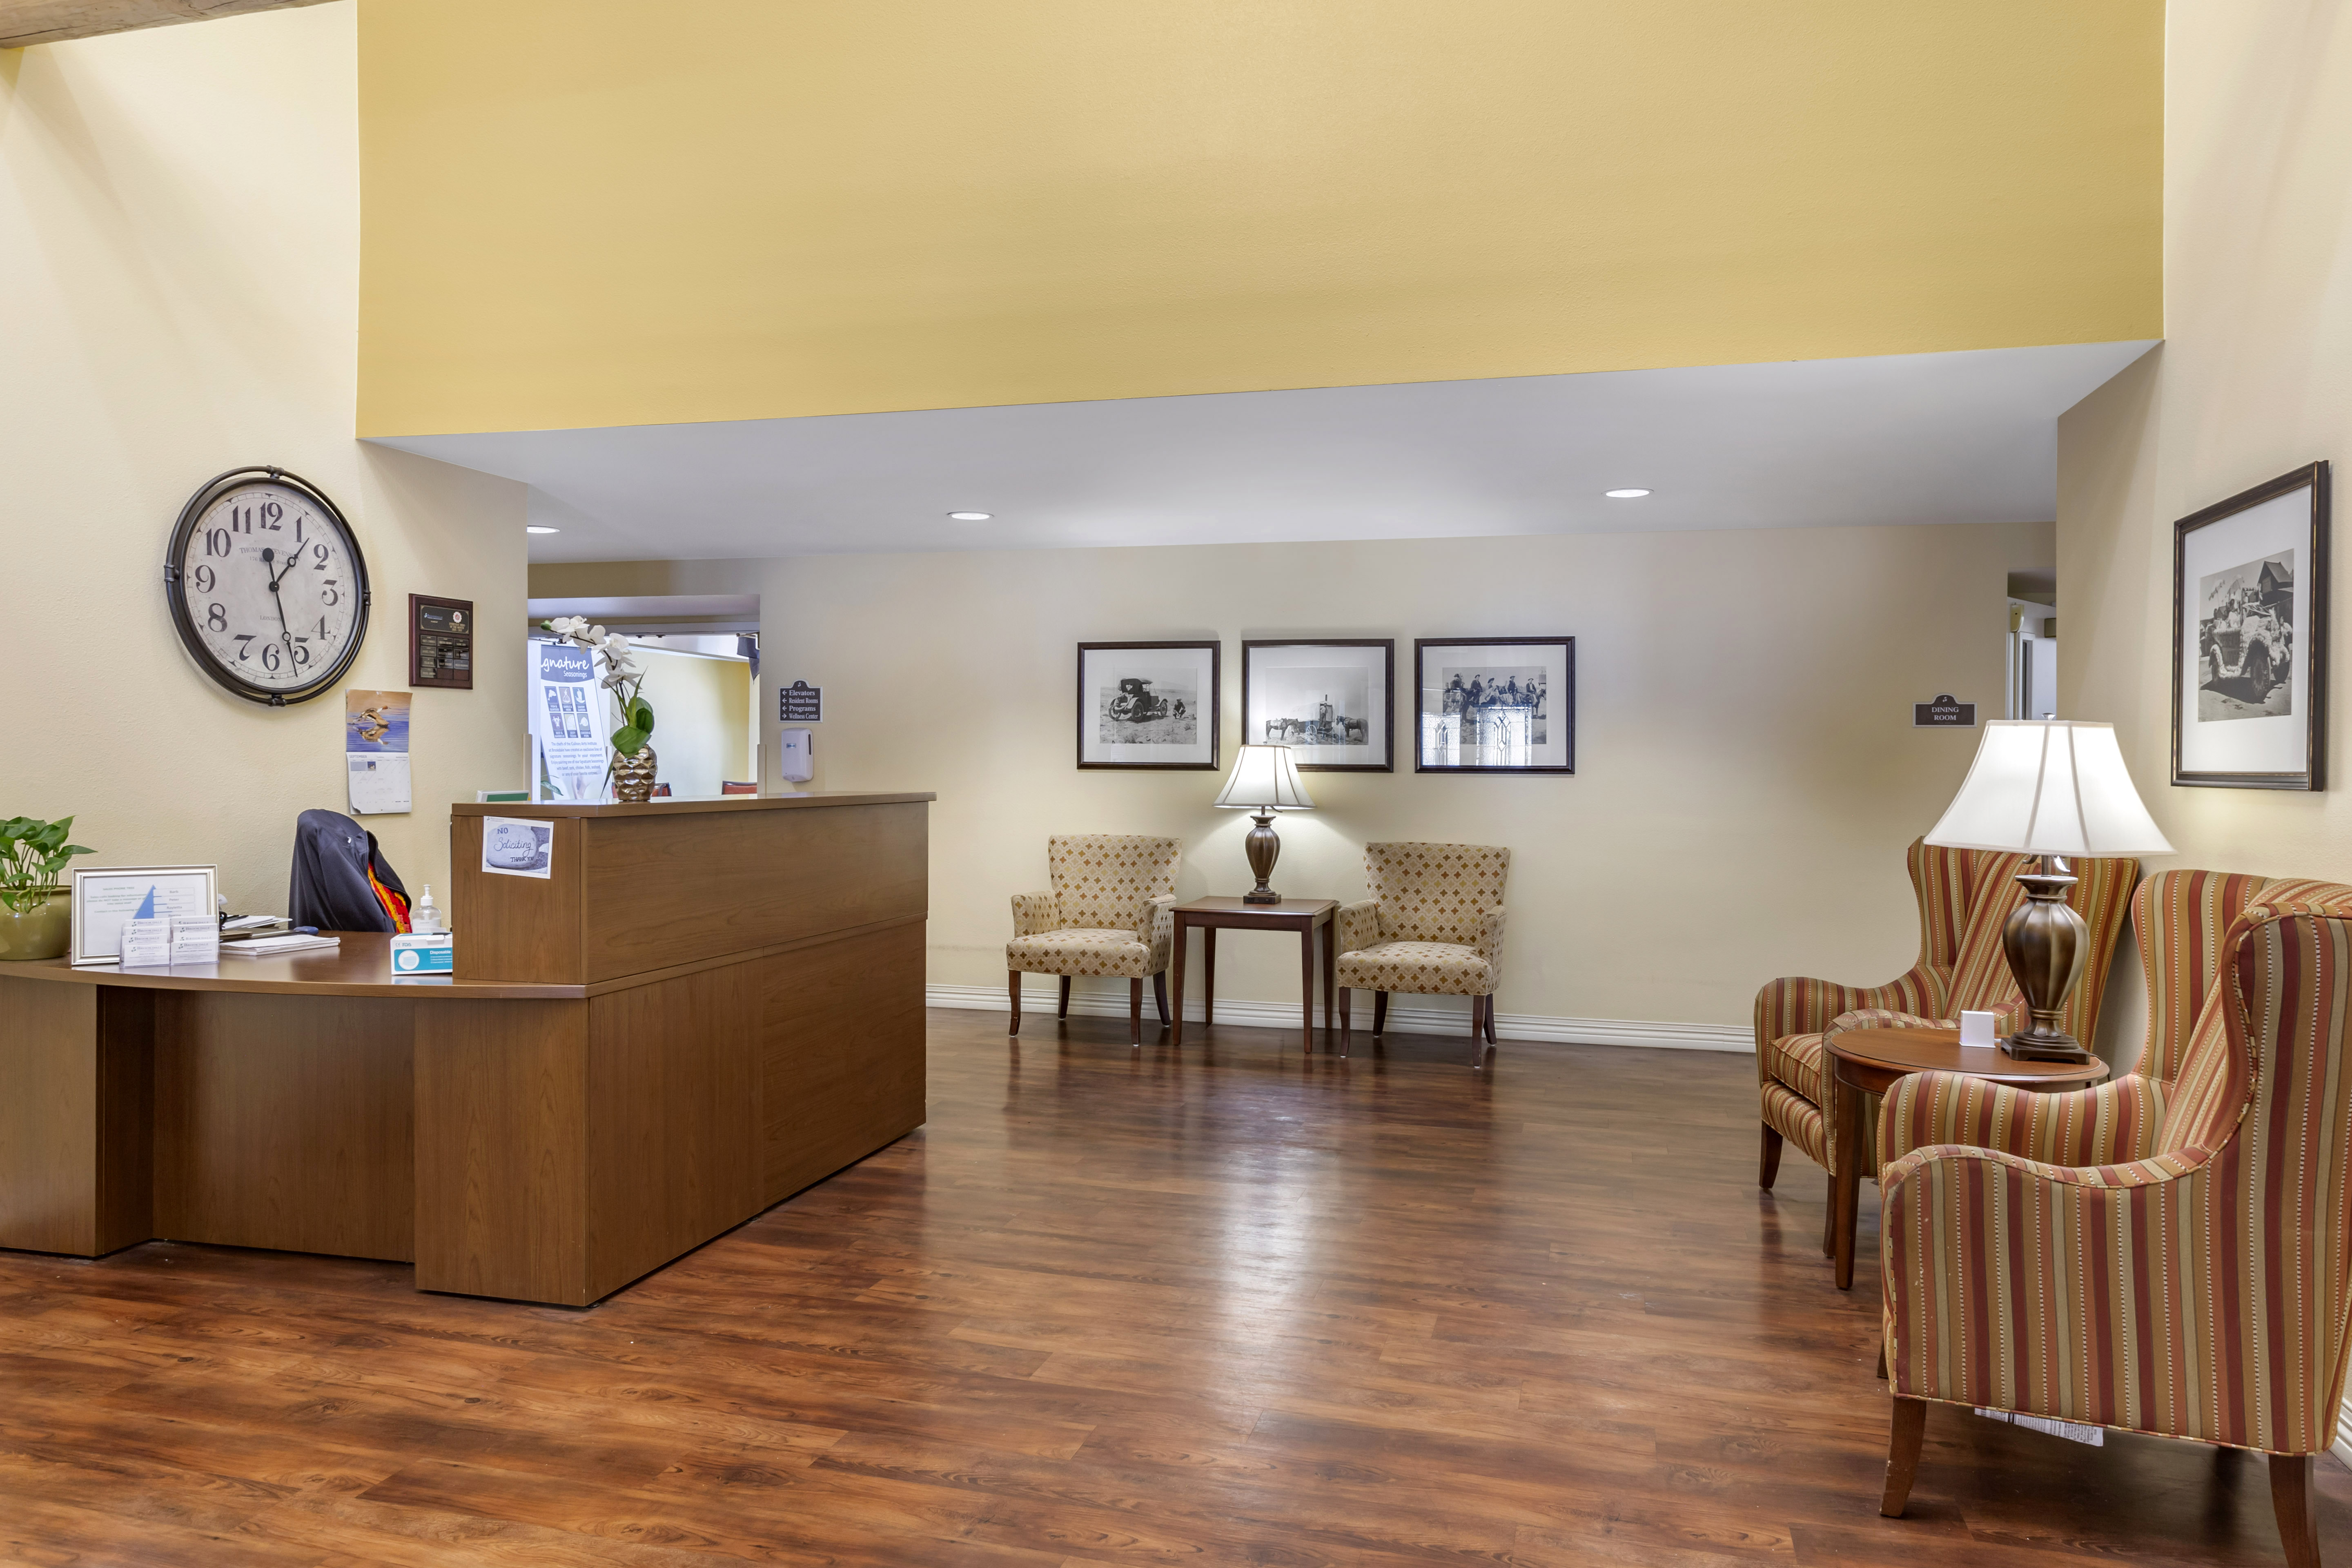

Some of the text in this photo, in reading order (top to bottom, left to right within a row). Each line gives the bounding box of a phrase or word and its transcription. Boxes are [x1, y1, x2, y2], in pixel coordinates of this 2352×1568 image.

[231, 505, 253, 535] 11
[258, 502, 283, 531] 12
[294, 516, 303, 543] 1
[205, 528, 232, 558] 10
[313, 544, 329, 570] 2
[195, 565, 216, 593] 9
[321, 579, 339, 606] 3
[207, 603, 228, 633] 8
[311, 614, 331, 640] 4
[232, 634, 257, 661] 7
[262, 643, 280, 671] 6
[294, 637, 310, 665] 5
[564, 670, 588, 679] Seasonings
[493, 837, 534, 858] Soliciting
